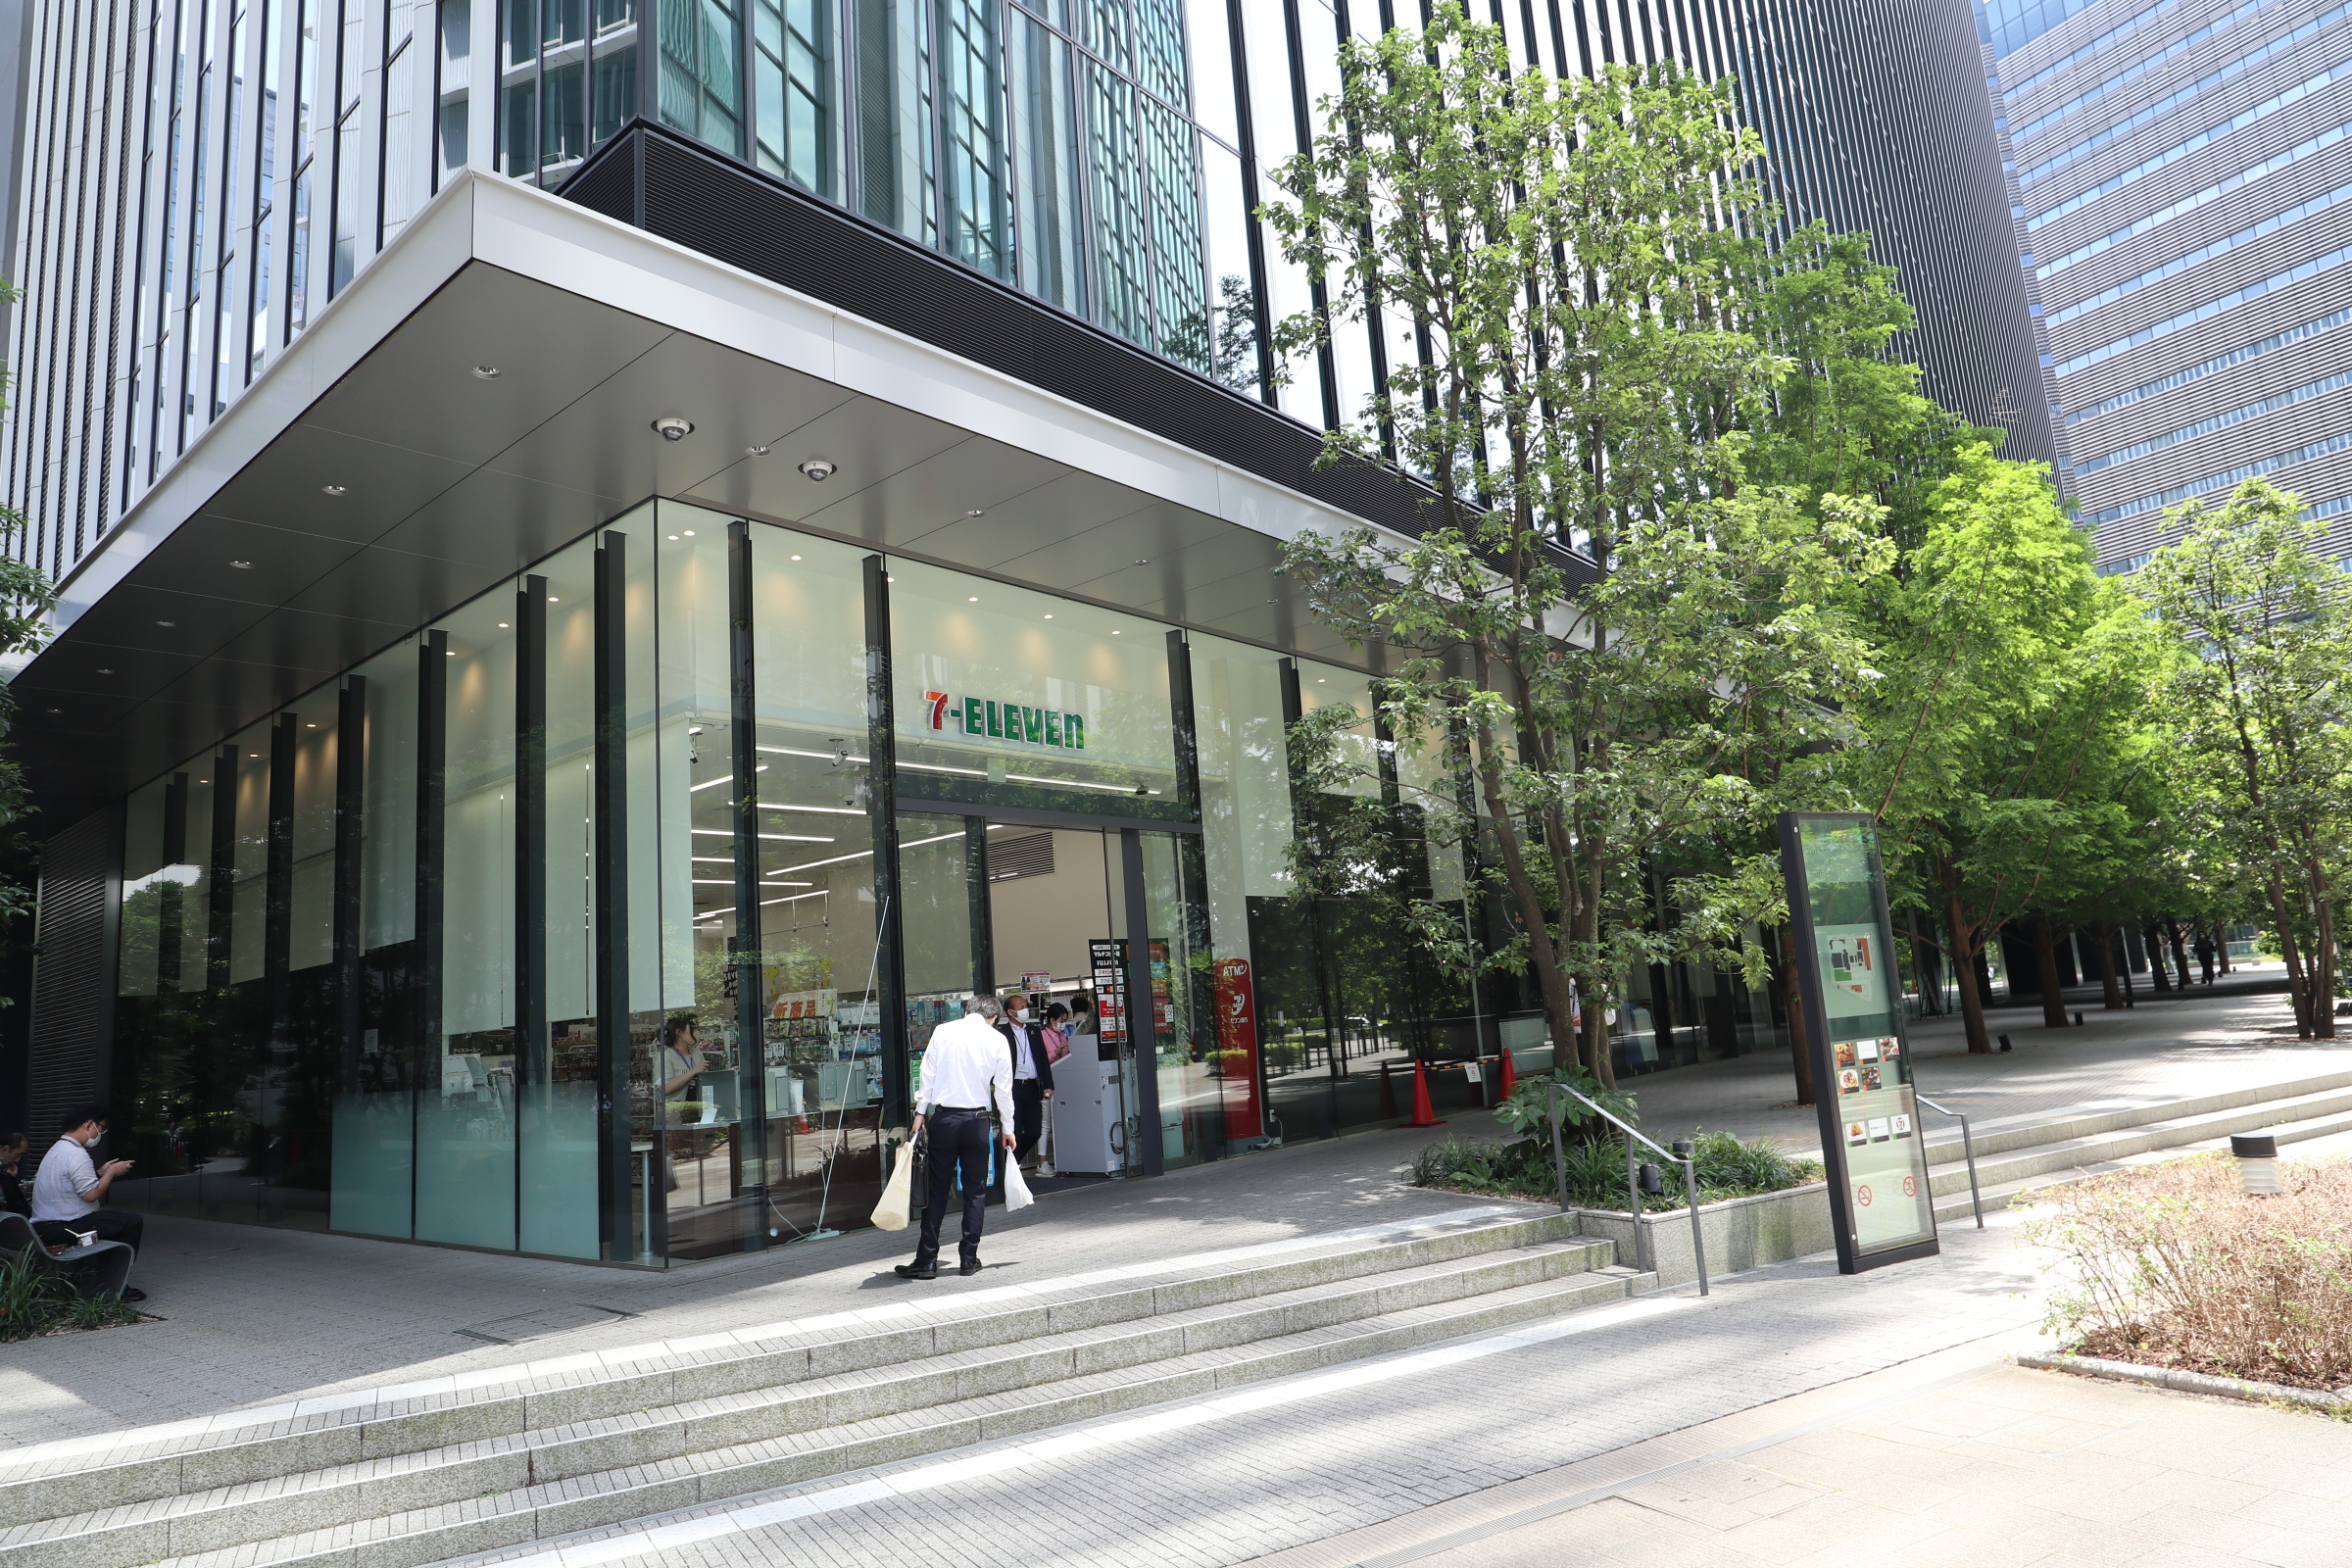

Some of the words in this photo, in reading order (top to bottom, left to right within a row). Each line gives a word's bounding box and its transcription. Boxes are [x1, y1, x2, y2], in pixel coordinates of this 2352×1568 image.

[1223, 965, 1242, 977] ATM
[772, 999, 816, 1018] 新商品
